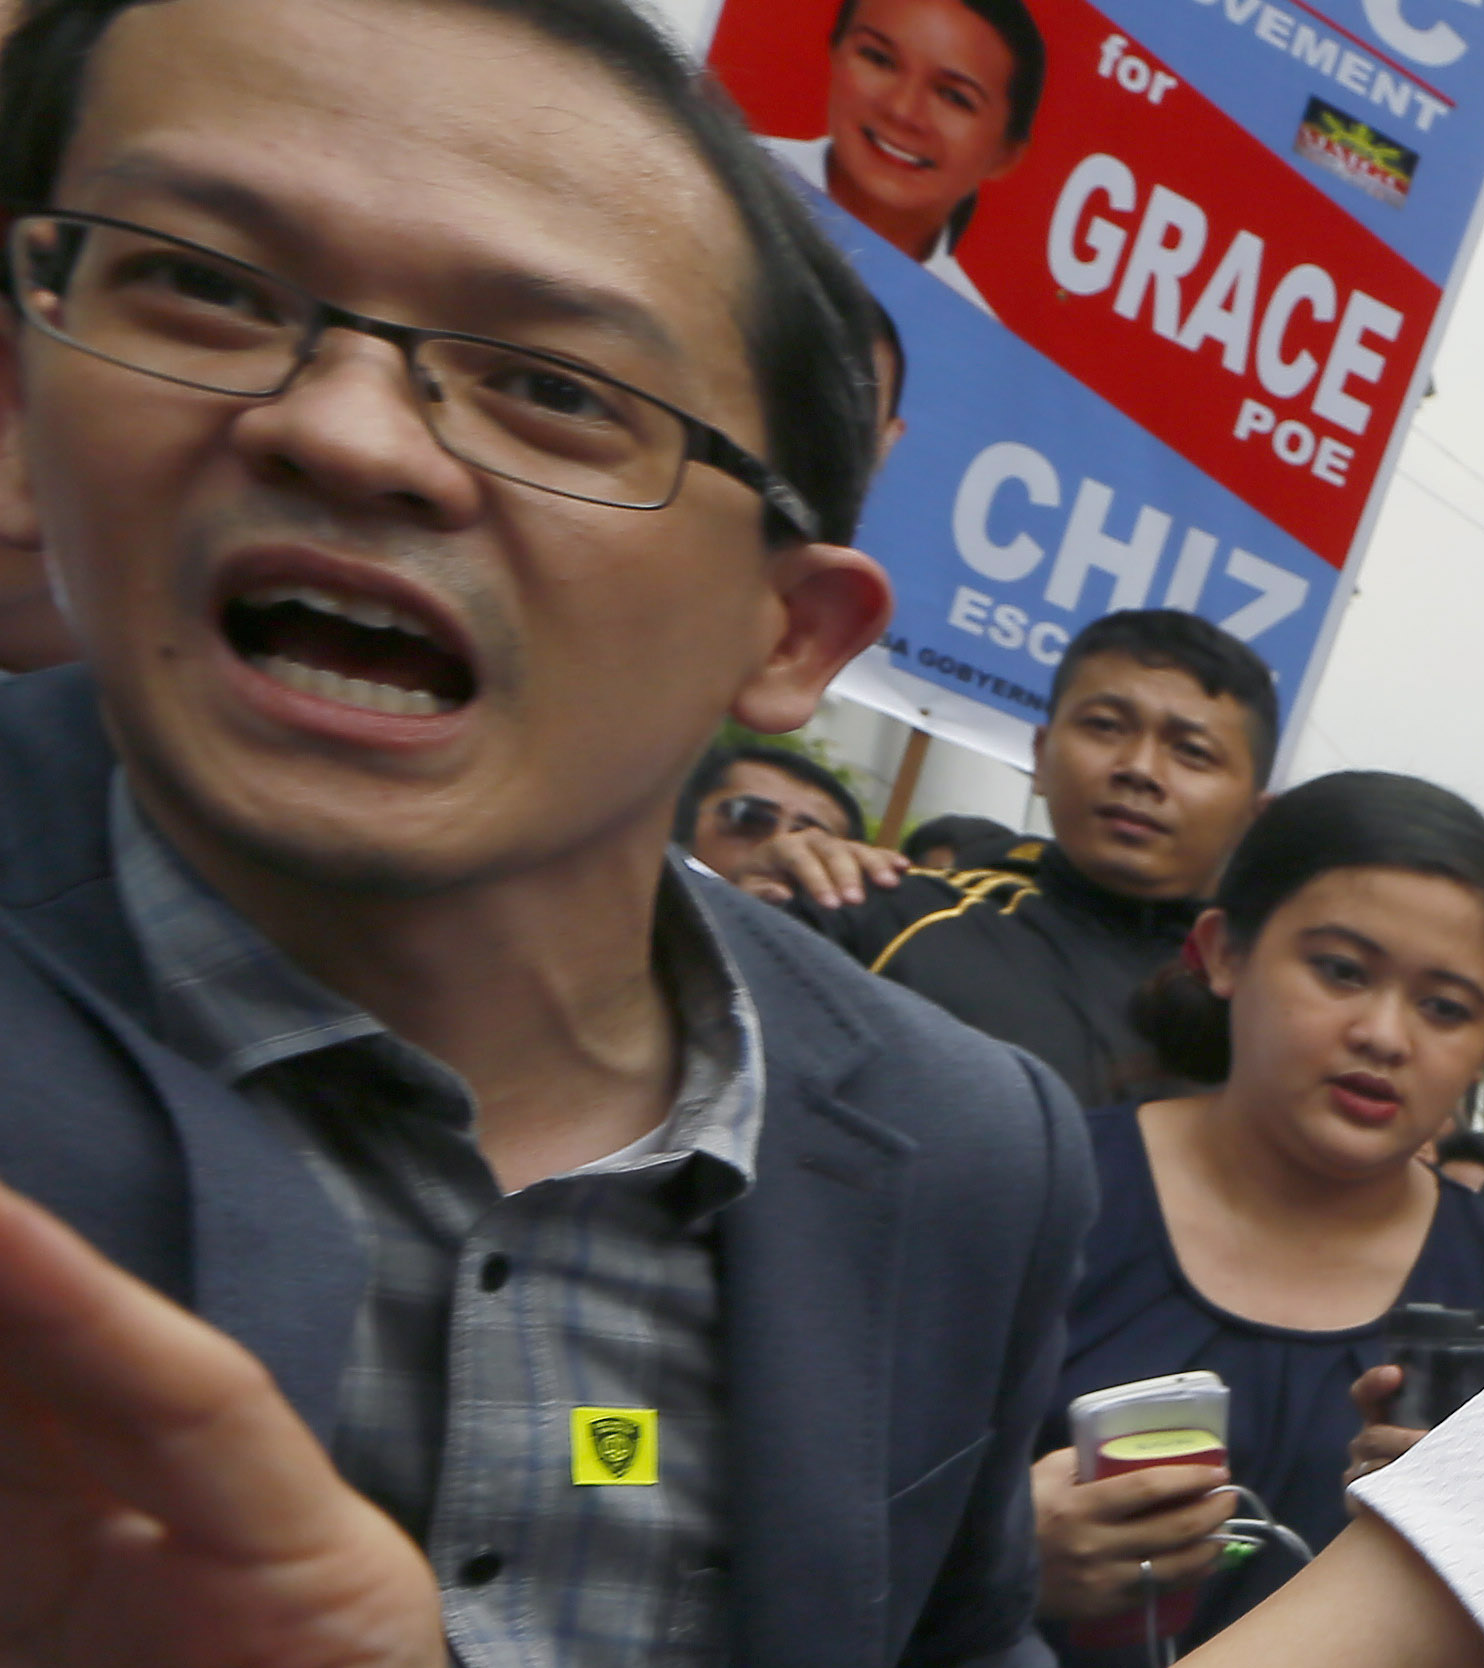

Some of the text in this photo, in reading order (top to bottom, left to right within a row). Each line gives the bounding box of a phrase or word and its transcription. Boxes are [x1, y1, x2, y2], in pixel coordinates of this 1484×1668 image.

[1098, 33, 1178, 106] for
[1199, 0, 1449, 132] VEMENT
[1046, 152, 1404, 437] GRACE
[1231, 399, 1356, 486] POE
[951, 440, 1310, 645] CHIZ
[917, 646, 1050, 712] GOBYERN
